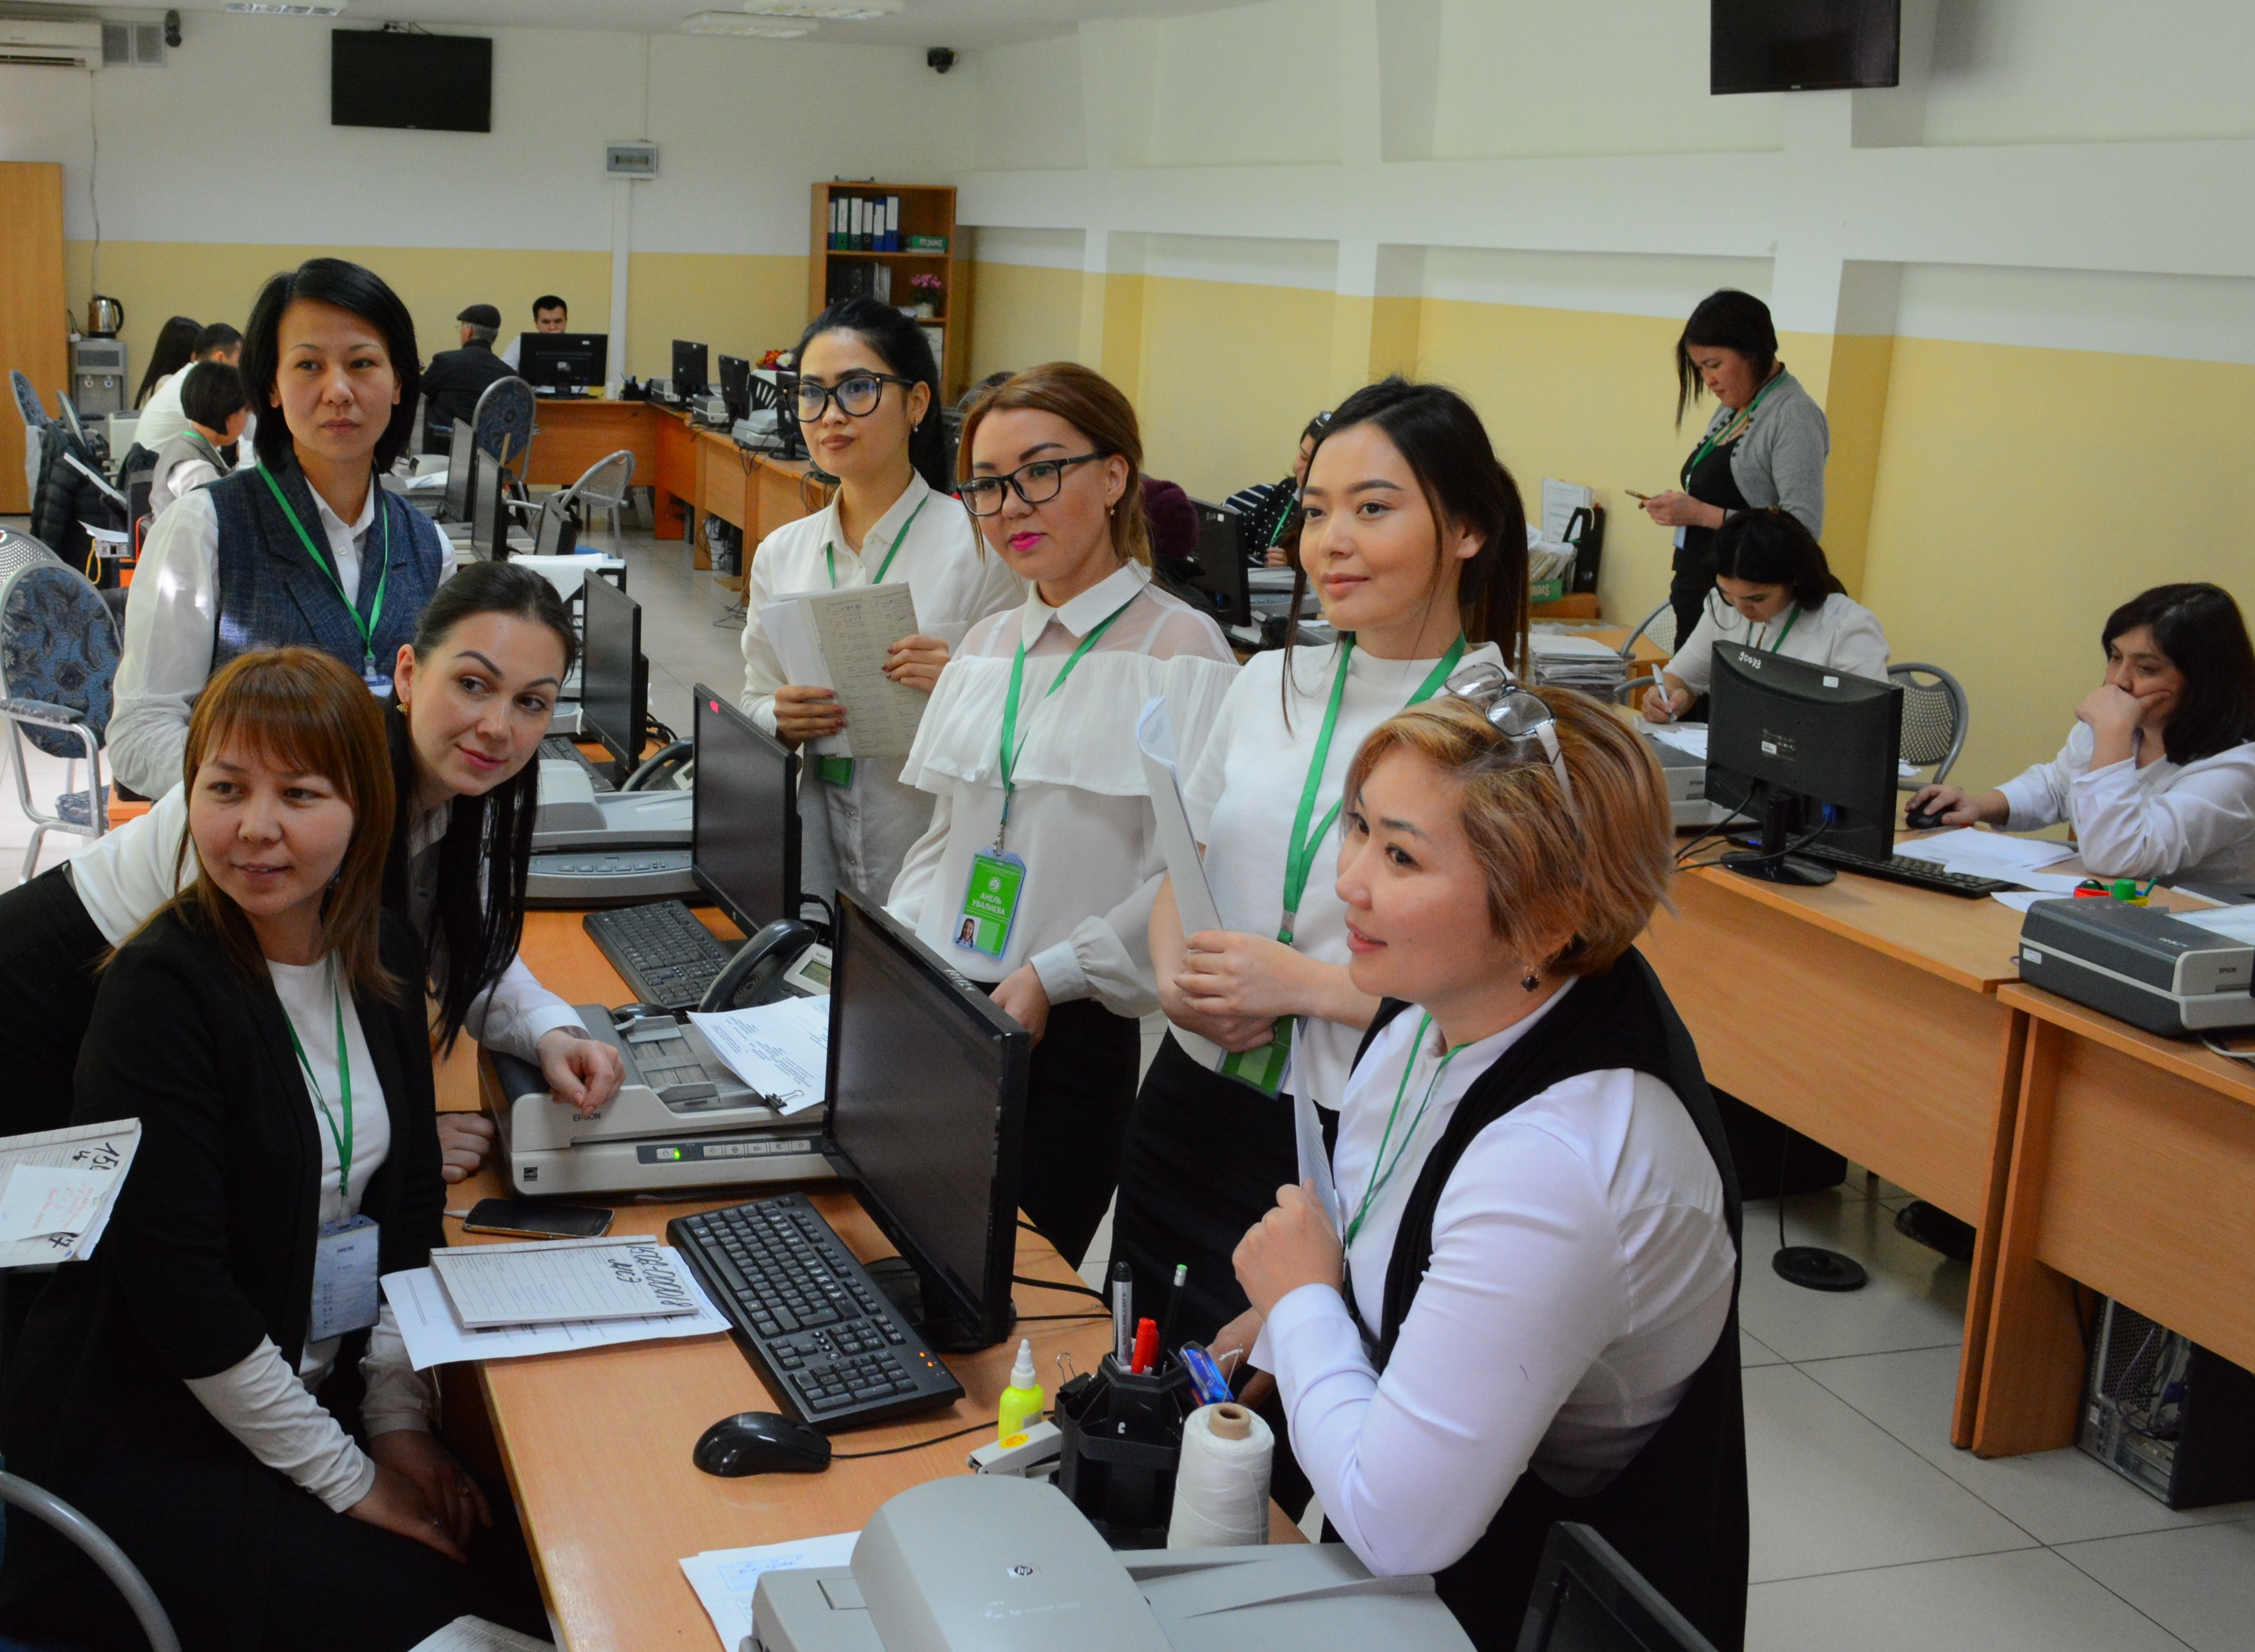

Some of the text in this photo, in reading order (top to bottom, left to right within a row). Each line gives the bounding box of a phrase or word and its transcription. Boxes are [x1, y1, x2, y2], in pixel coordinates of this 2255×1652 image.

[980, 892, 1002, 905] АНЕЛЬ
[972, 900, 1005, 915] УВАЛИЕВА
[1015, 1566, 1033, 1576] hp
